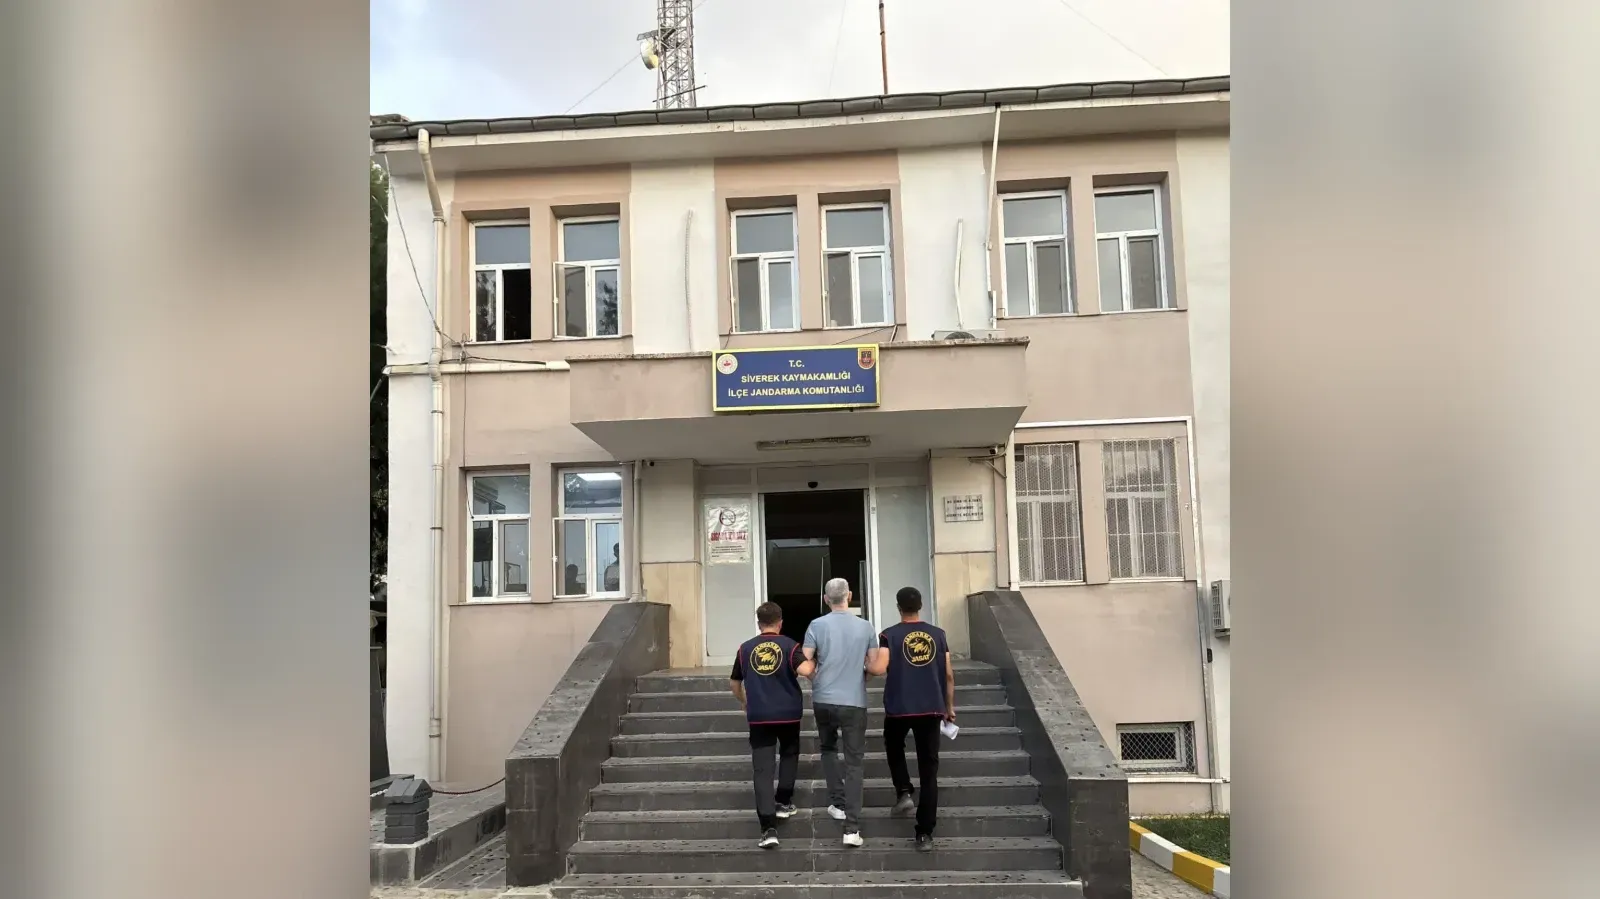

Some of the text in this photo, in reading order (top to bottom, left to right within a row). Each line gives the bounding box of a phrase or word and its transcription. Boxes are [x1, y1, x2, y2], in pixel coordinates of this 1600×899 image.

[788, 359, 805, 368] T.C.
[741, 371, 851, 383] SİVEREK KAYMAKAMLIĞI
[728, 383, 865, 398] İLÇE JANDARMA KOMUTANLIĞI
[911, 654, 930, 663] JASAT
